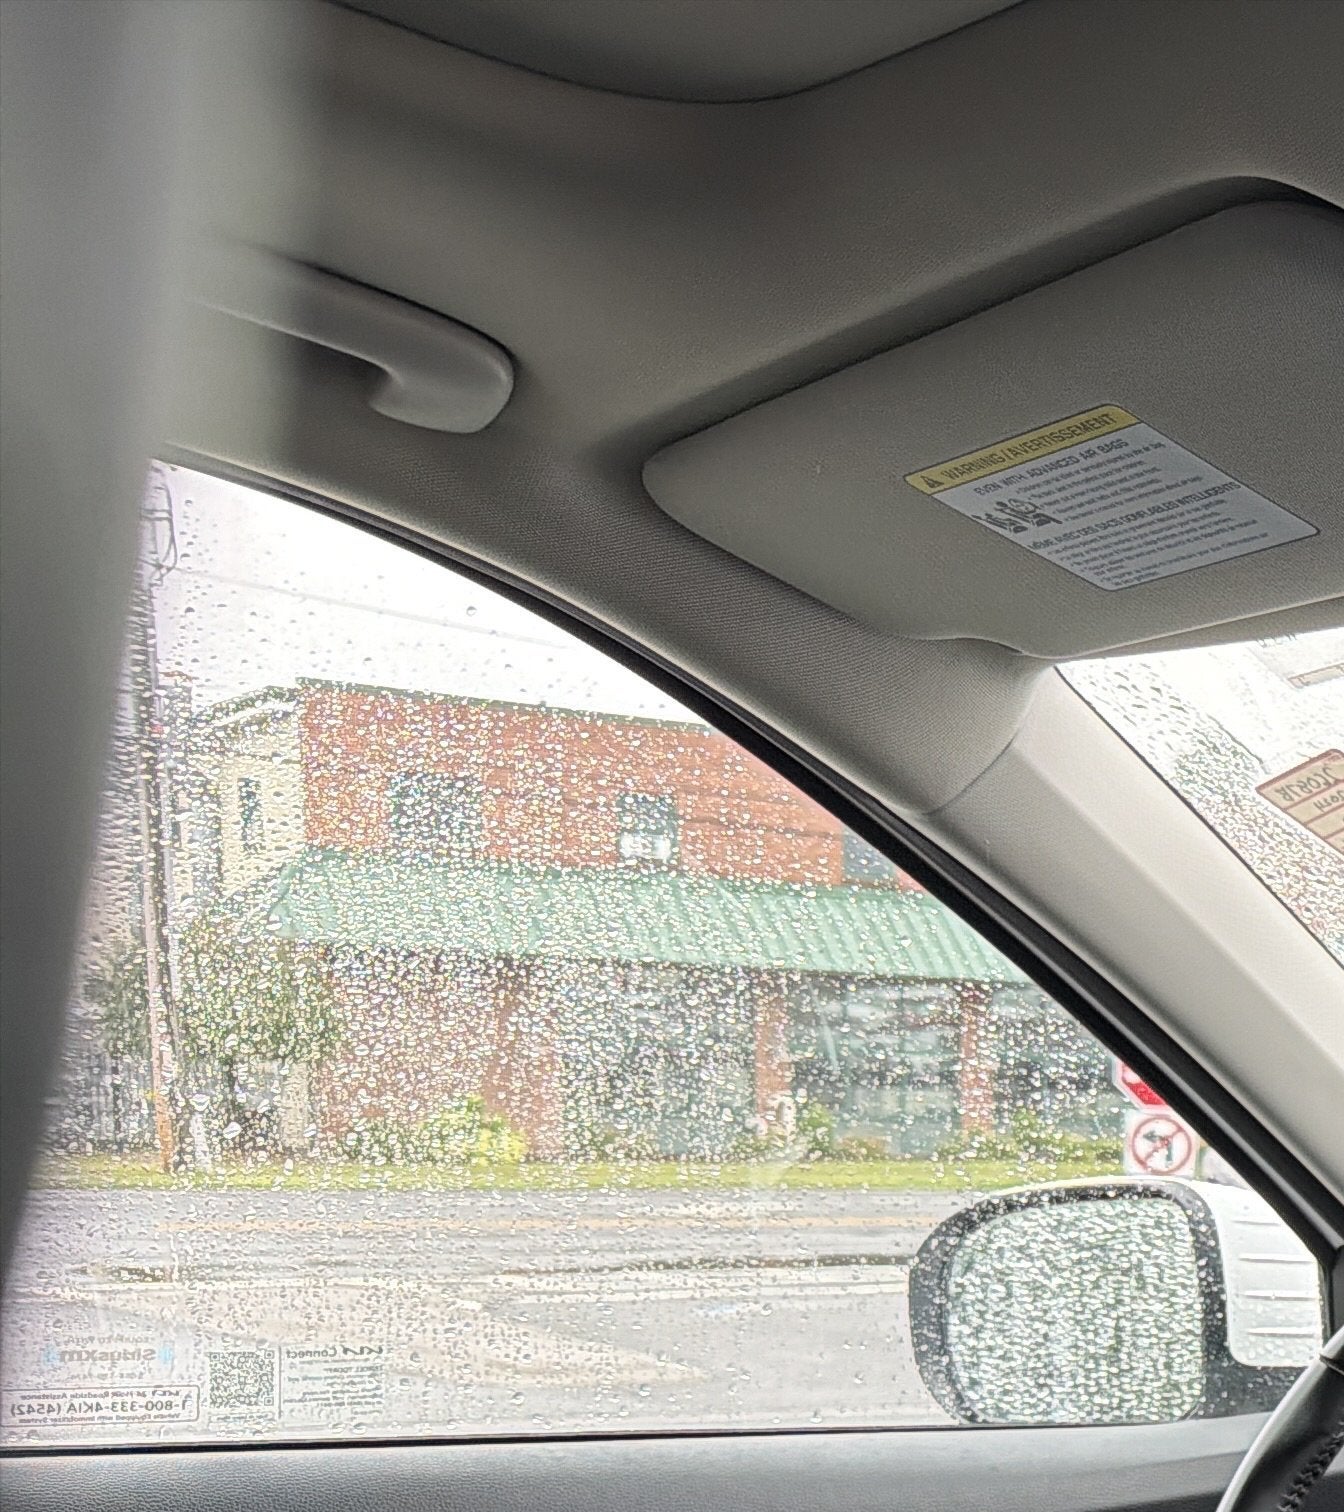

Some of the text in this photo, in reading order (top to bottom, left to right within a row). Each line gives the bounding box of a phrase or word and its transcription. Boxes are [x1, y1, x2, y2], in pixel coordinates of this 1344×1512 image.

[941, 452, 1008, 481] WARNING
[1008, 413, 1118, 458] AVERTISSEMENT
[1002, 473, 1027, 488] WITH
[1025, 455, 1082, 479] ADVANCED
[1096, 438, 1131, 455] BAGS
